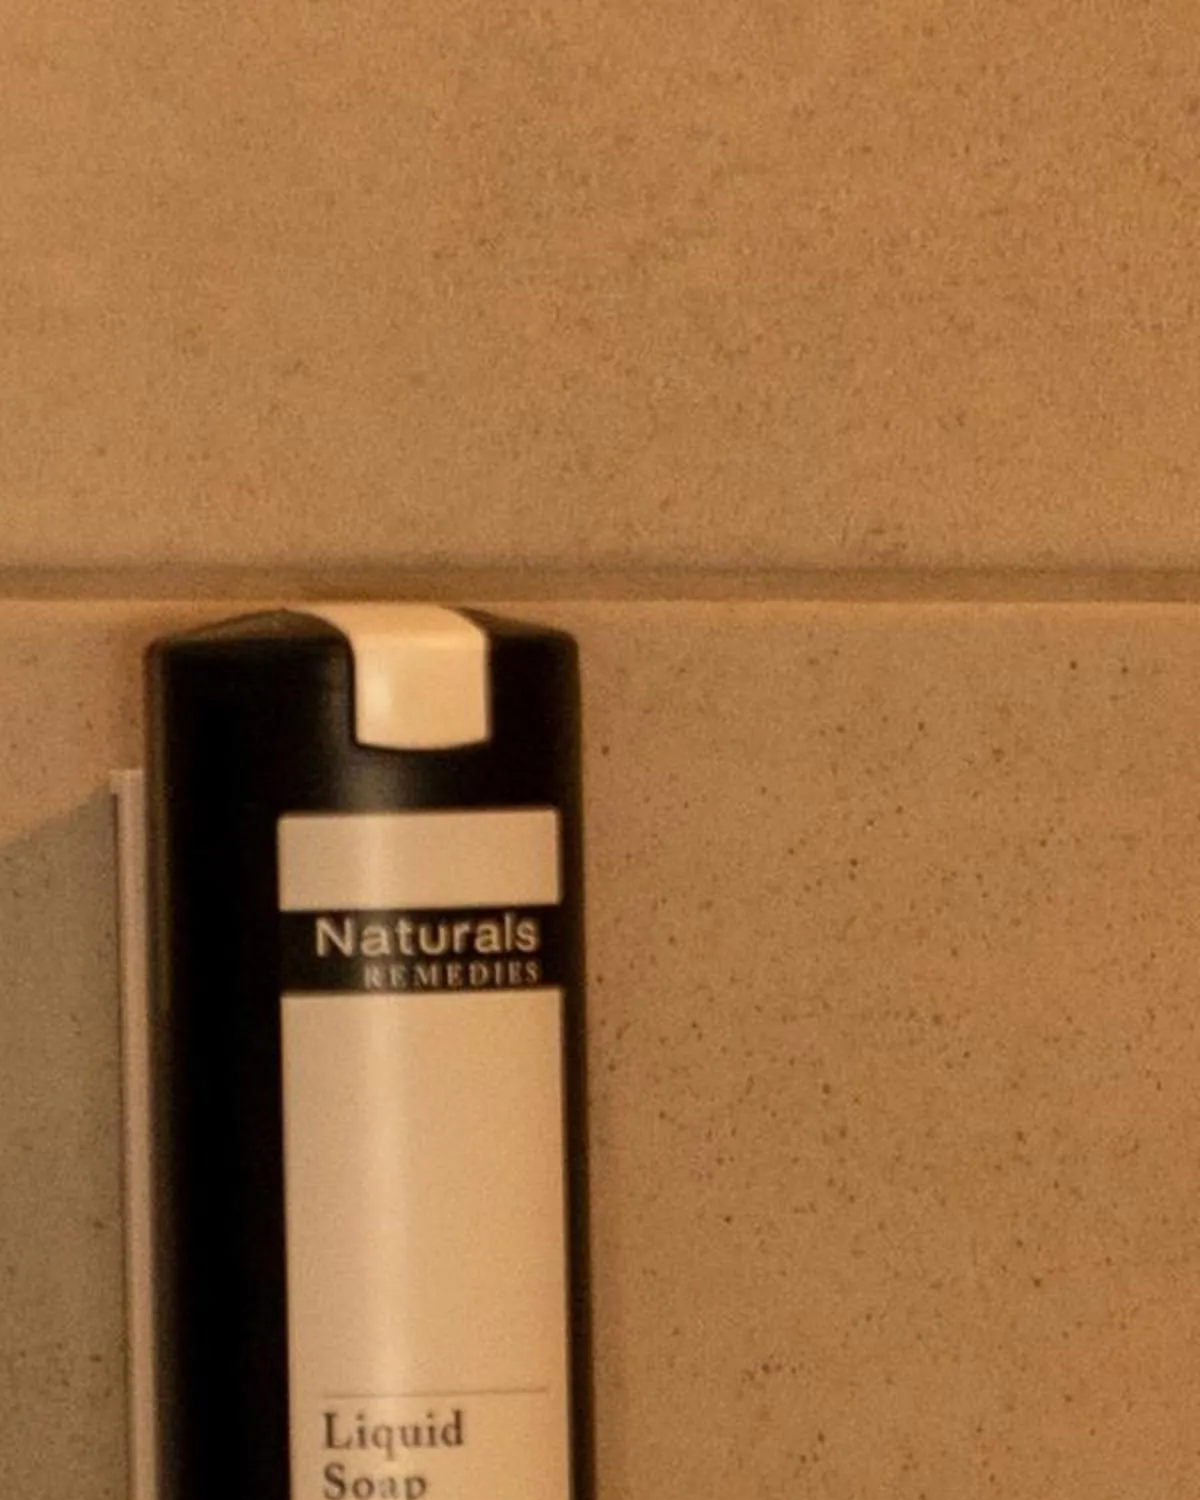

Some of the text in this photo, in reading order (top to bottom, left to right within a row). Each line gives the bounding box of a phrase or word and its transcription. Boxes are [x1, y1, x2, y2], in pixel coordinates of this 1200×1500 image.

[315, 913, 541, 957] Naturals
[363, 960, 542, 987] REMEDIES
[323, 1410, 464, 1460] Liquid
